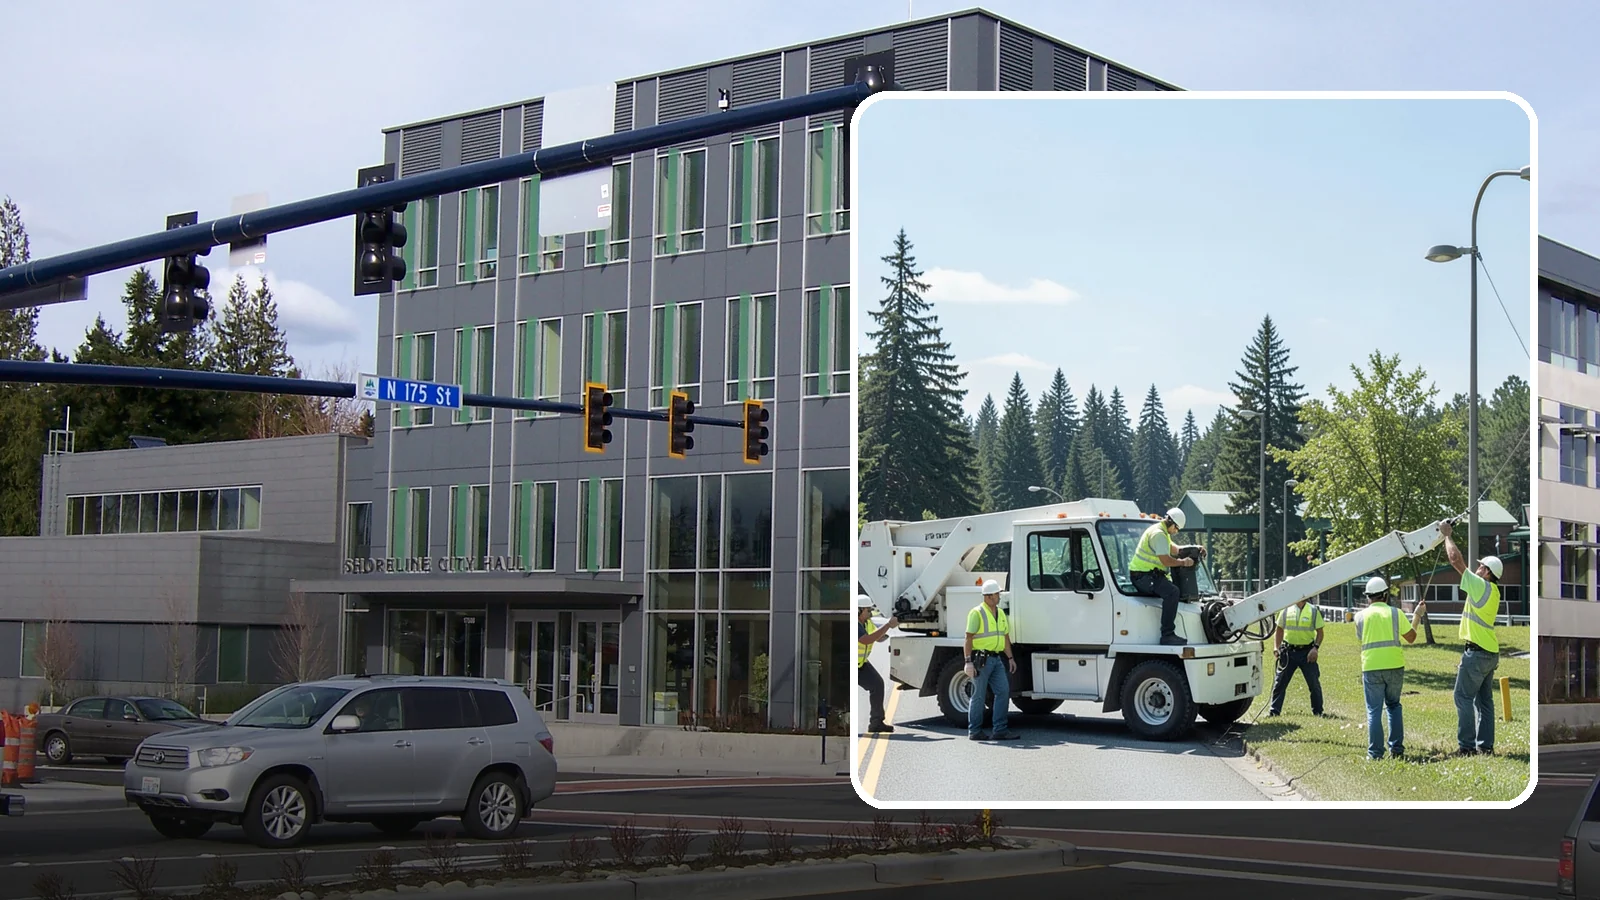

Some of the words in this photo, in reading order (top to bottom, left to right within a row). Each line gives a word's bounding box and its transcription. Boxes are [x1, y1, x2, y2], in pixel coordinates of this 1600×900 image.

[387, 380, 396, 400] N
[405, 383, 427, 403] 175
[436, 387, 451, 406] St
[343, 557, 432, 574] SHORELINE
[438, 556, 474, 572] CITY
[484, 555, 525, 571] HALL
